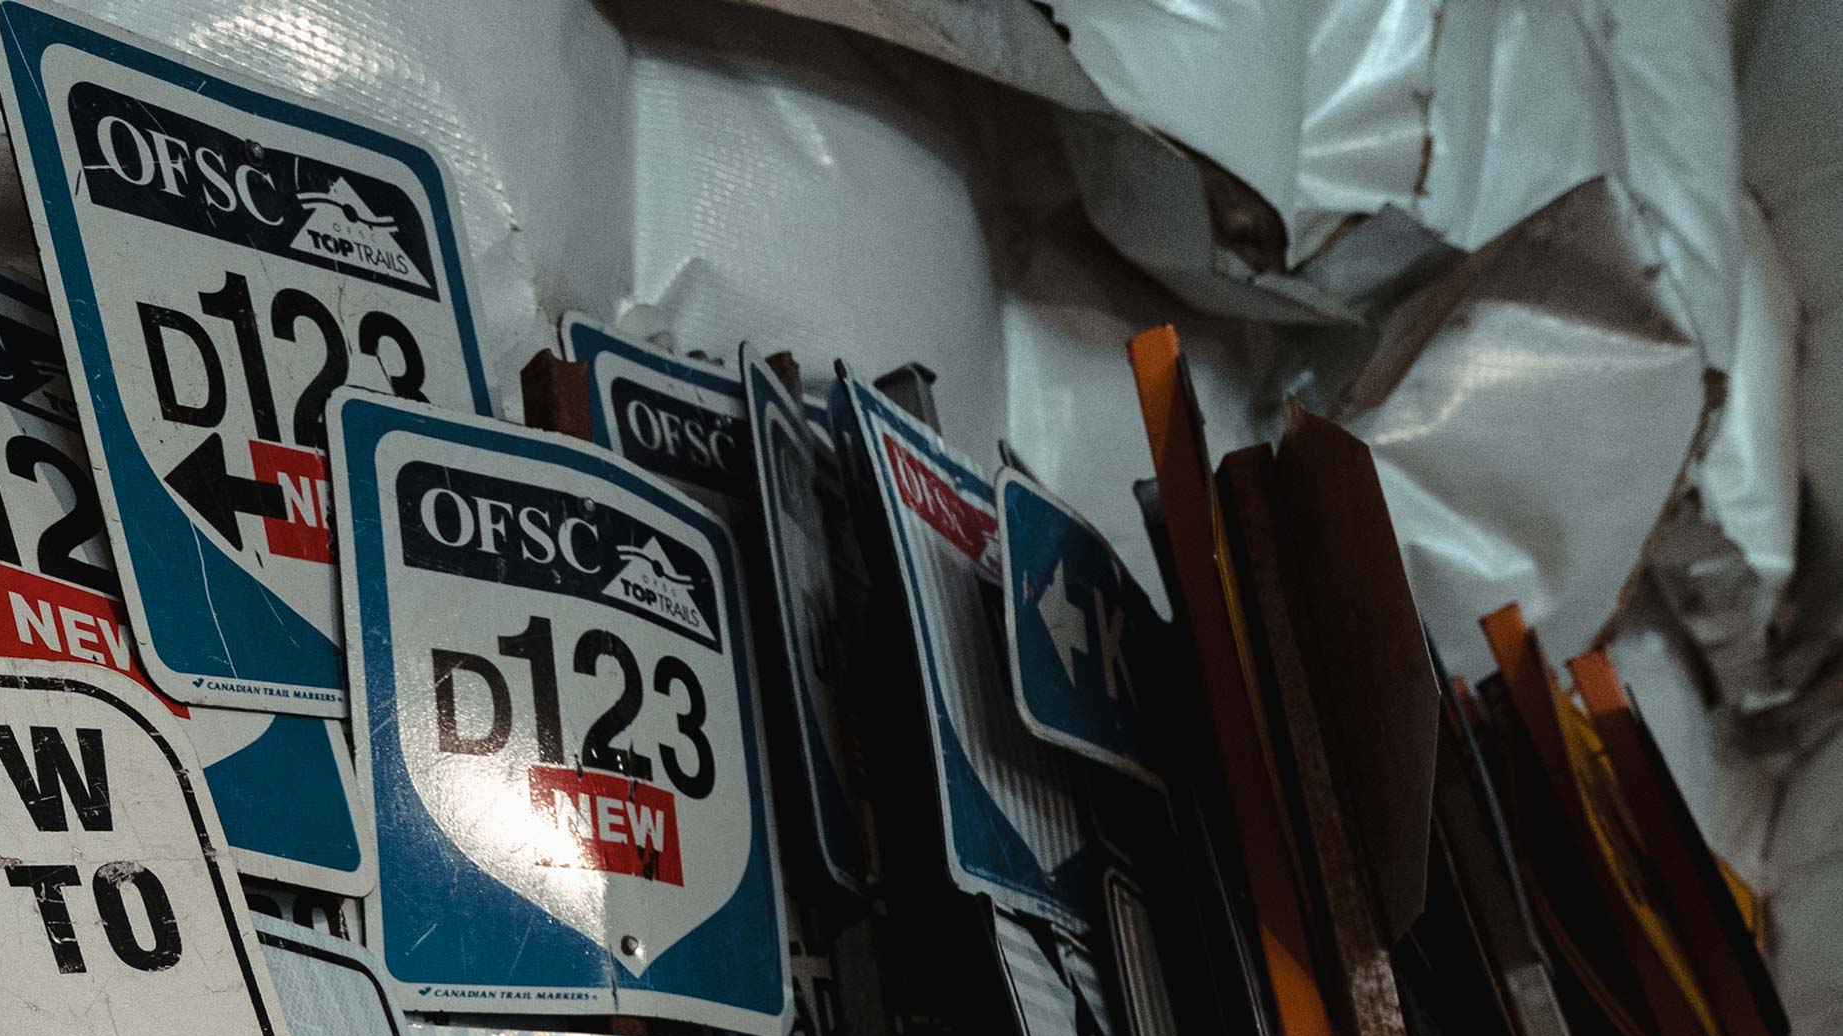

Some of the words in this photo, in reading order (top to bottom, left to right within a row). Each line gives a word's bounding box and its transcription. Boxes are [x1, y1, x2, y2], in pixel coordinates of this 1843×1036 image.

[97, 115, 284, 226] OFSC
[307, 229, 354, 257] TOP
[353, 241, 409, 275] TRAILS
[136, 270, 431, 447] D123
[627, 400, 735, 474] OFSC
[420, 487, 602, 574] OFSC
[620, 577, 658, 605] TOP
[657, 593, 700, 628] TRAILS
[207, 681, 260, 696] CANADIAN
[263, 687, 290, 698] TRAIL
[293, 690, 335, 703] MARKERS
[430, 615, 716, 800] D123
[554, 789, 664, 853] NEW
[4, 859, 184, 976] TO
[434, 988, 498, 998] CANADIAN
[499, 990, 533, 1000] TRAIL
[535, 991, 590, 1001] MARKERS
